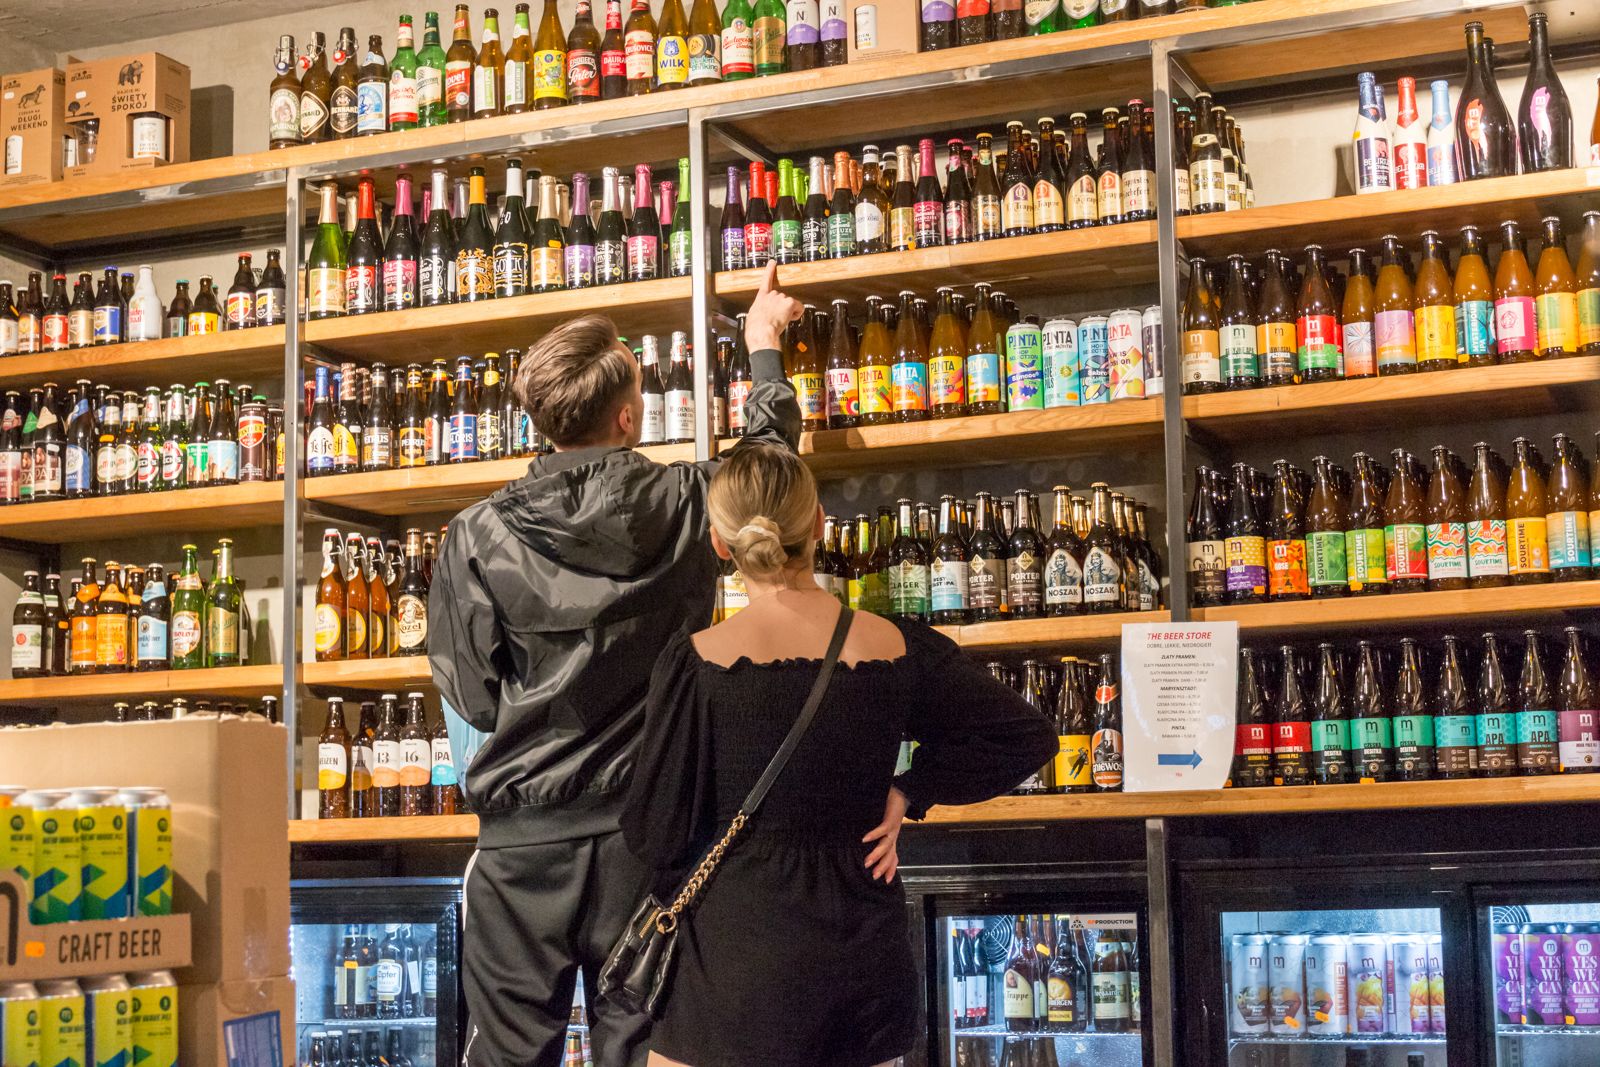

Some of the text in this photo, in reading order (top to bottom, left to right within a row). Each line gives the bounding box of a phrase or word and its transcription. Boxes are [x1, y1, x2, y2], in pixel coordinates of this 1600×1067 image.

[796, 11, 805, 21] N
[828, 6, 837, 17] N
[659, 59, 686, 68] WILK
[568, 66, 596, 86] Porter
[112, 92, 147, 104] ŚWIĘTY
[111, 101, 148, 112] SPOKÓJ
[18, 114, 41, 123] DŁUGI
[10, 120, 48, 132] WEEKEND
[1008, 333, 1038, 348] PINTA
[1043, 330, 1073, 345] PINTA
[892, 366, 919, 379] PINTA
[930, 360, 955, 373] PINTA
[825, 371, 850, 386] PINTA
[859, 369, 884, 383] PINTA
[1567, 516, 1575, 563] SOURTIME
[1203, 544, 1215, 556] m
[1434, 560, 1462, 569] SOURTIME
[1474, 558, 1503, 566] SOURTIME
[1010, 571, 1040, 580] PORTER
[893, 580, 920, 589] LAGER
[1085, 585, 1115, 596] NOSZAK
[1048, 586, 1079, 598] NOSZAK
[1147, 631, 1212, 640] THE BEER STORE
[1400, 719, 1413, 731] m
[1487, 716, 1500, 729] m
[1532, 714, 1546, 726] m
[1325, 723, 1338, 735] m
[1365, 721, 1378, 733] m
[1485, 733, 1504, 745] APA
[1531, 730, 1550, 743] APA
[377, 751, 390, 764] 13
[404, 750, 419, 763] 16
[434, 751, 450, 762] IPA
[58, 928, 162, 964] CRAFT BEER
[1361, 957, 1375, 969] m
[1538, 956, 1561, 969] YES
[1571, 955, 1598, 969] YES
[376, 970, 397, 980] Zipfer
[1573, 968, 1597, 982] WE
[1538, 981, 1562, 994] CAN
[1571, 981, 1600, 995] CAN
